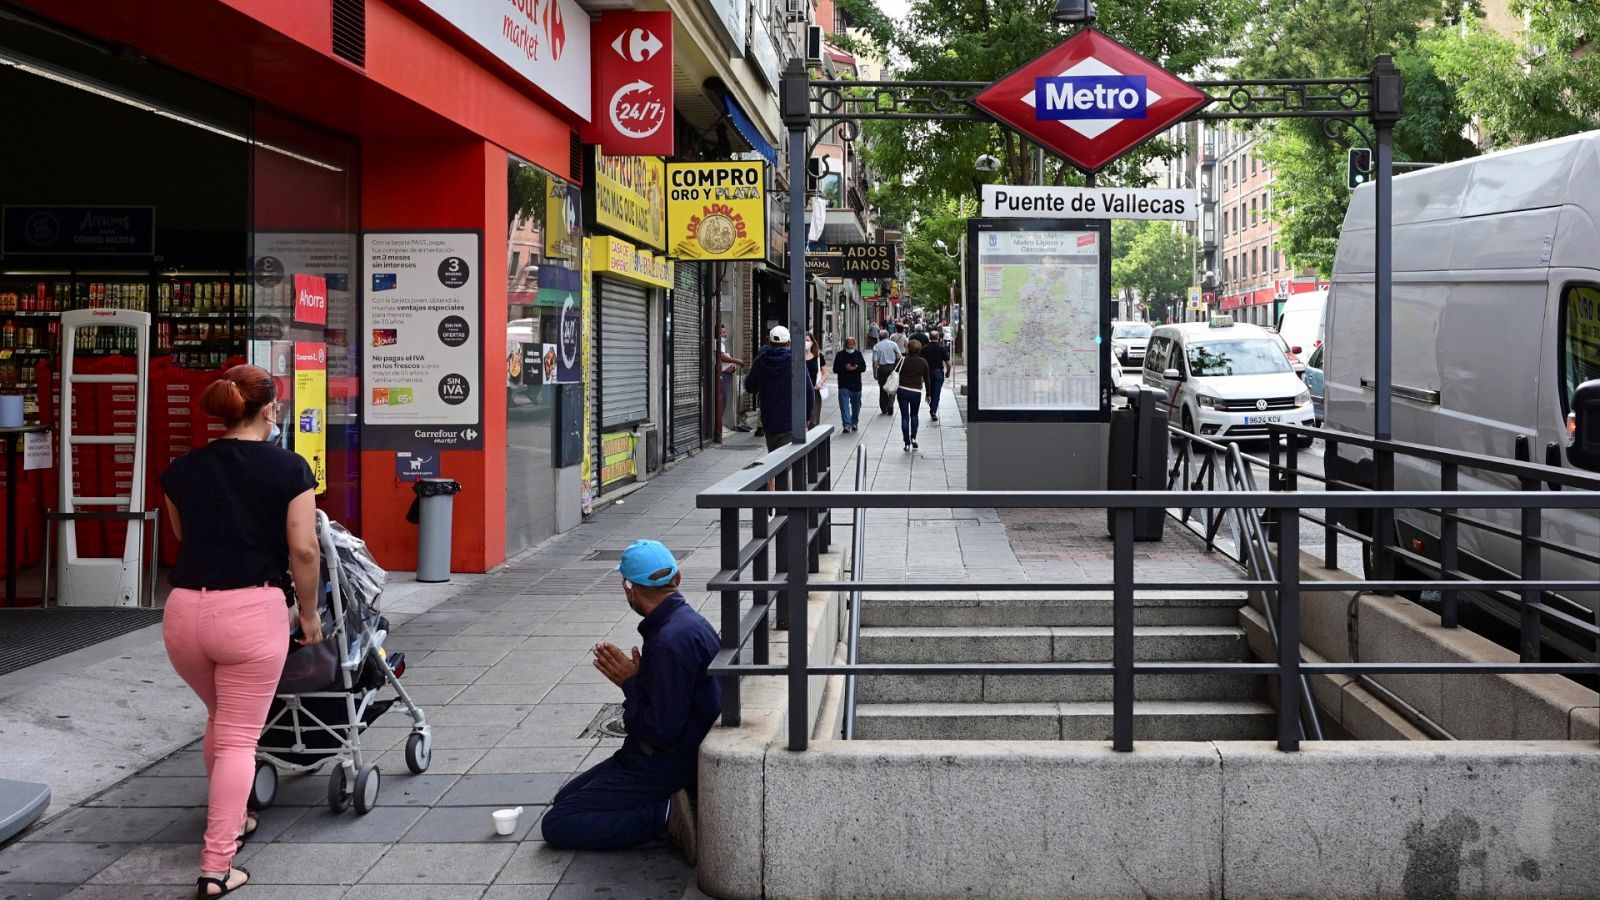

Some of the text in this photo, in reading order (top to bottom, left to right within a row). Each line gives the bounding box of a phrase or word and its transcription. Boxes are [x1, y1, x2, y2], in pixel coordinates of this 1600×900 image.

[503, 14, 539, 61] market
[1045, 82, 1139, 110] Metro
[619, 102, 661, 121] 24/7
[672, 168, 759, 187] COMPRO
[671, 187, 761, 201] ORO Y PLATA
[995, 191, 1185, 214] Puente de Vallecas
[686, 203, 748, 241] LOS ADOLFOS
[448, 258, 460, 272] 3
[300, 289, 324, 309] Ahorra
[1249, 415, 1281, 424] 9624 KCV
[415, 430, 457, 438] Carrefour
